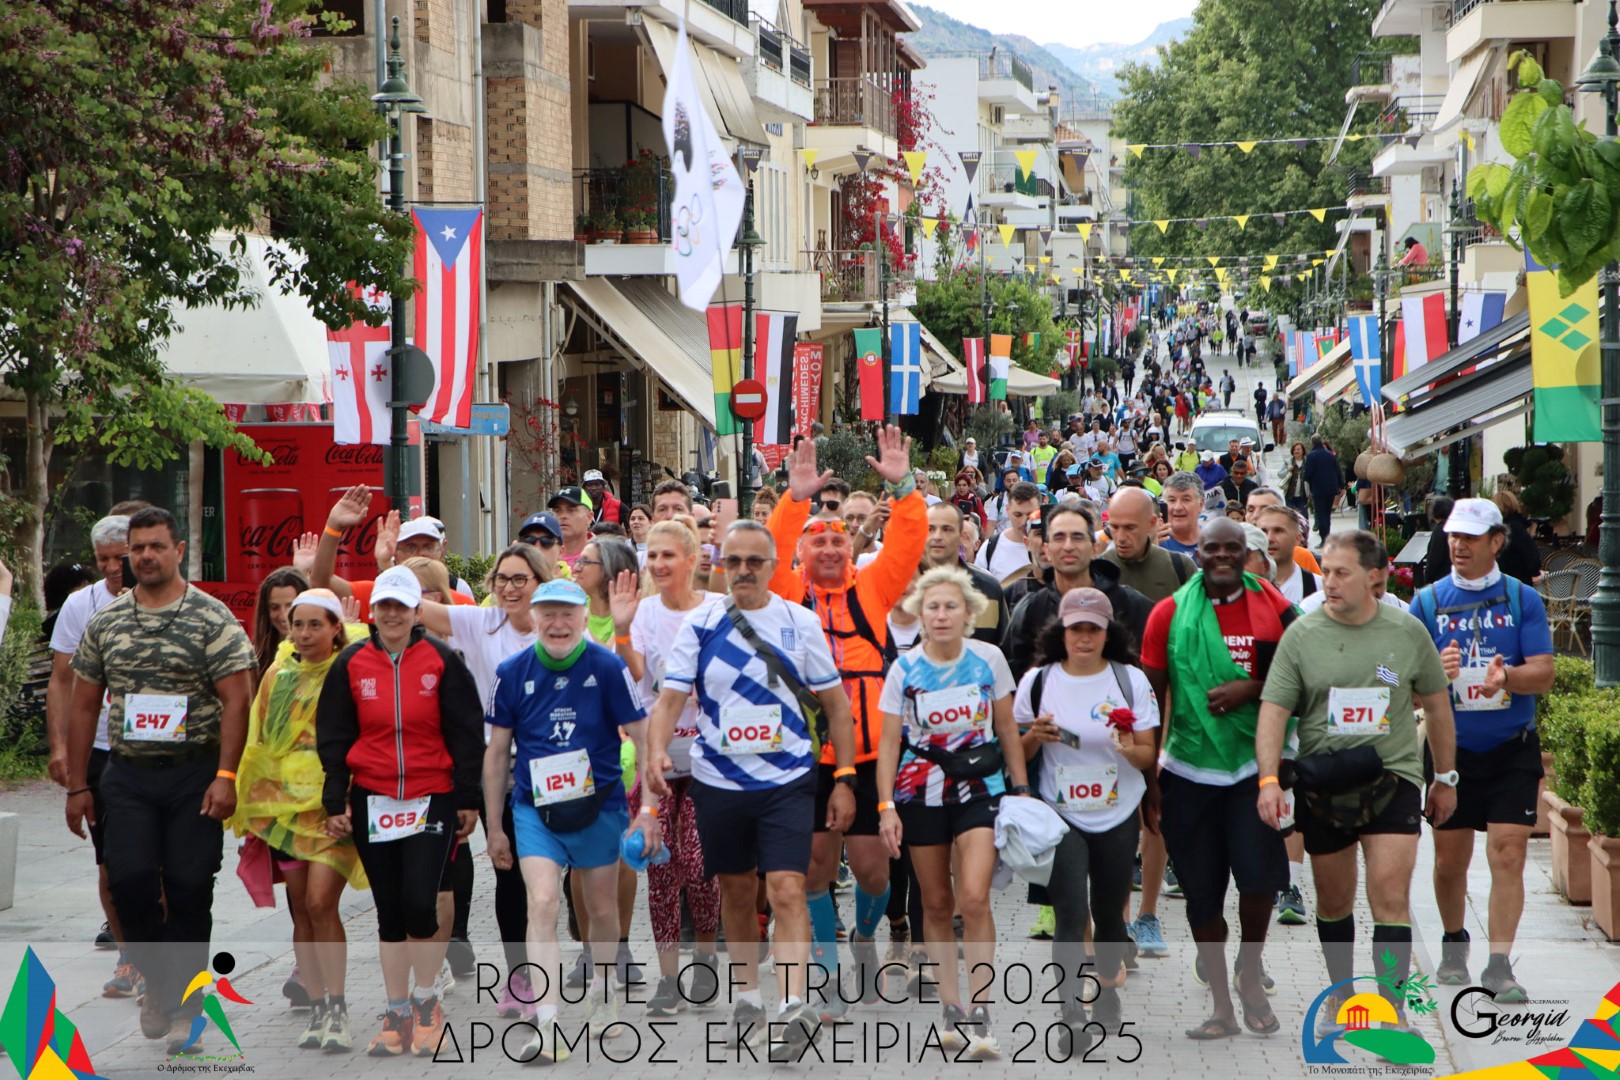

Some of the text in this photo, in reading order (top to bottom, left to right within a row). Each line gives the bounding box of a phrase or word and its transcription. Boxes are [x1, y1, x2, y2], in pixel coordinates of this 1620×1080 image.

[136, 713, 171, 729] 247
[928, 706, 971, 726] 004
[1342, 706, 1373, 723] 271
[728, 724, 772, 742] 002
[545, 772, 576, 792] 124
[1069, 783, 1103, 799] 108
[379, 811, 417, 829] 063
